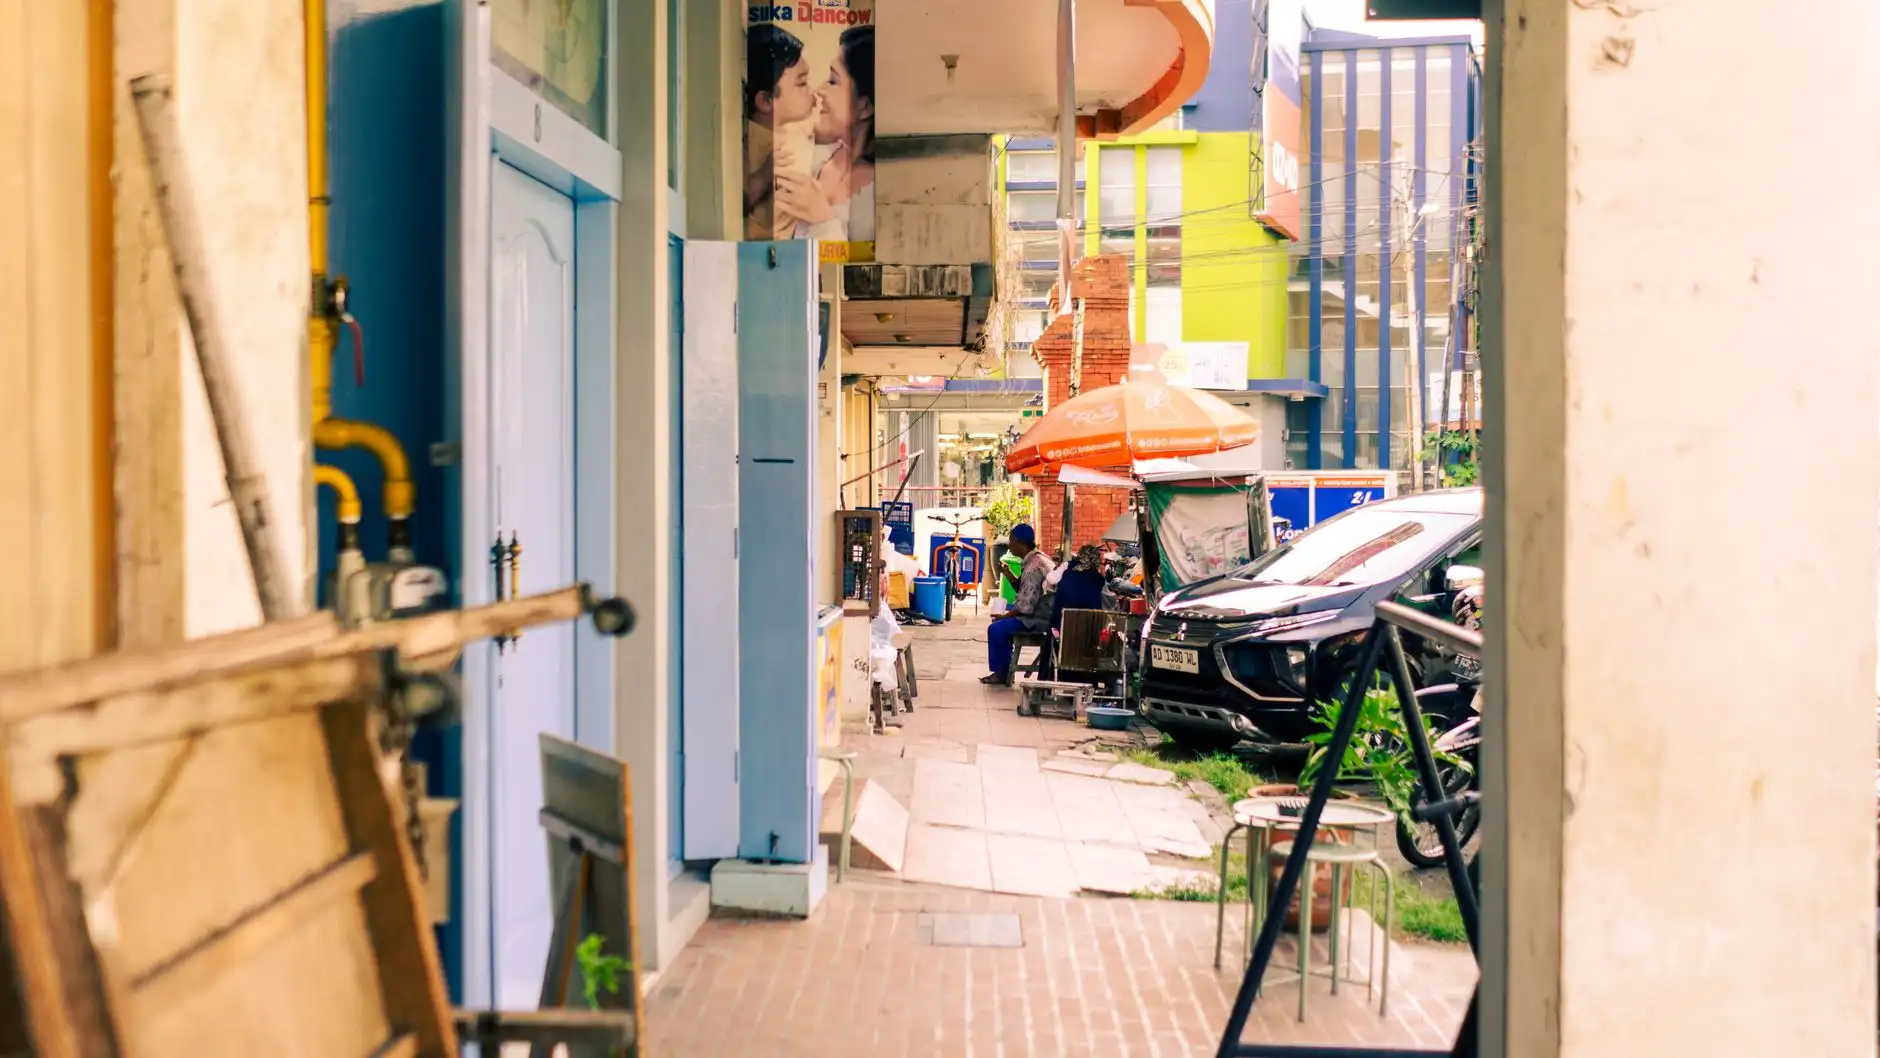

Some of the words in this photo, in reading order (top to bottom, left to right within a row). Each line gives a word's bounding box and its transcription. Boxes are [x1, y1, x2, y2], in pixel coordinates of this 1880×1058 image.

[749, 2, 792, 22] suka
[798, 2, 872, 25] Dancow
[1153, 647, 1162, 660] AD
